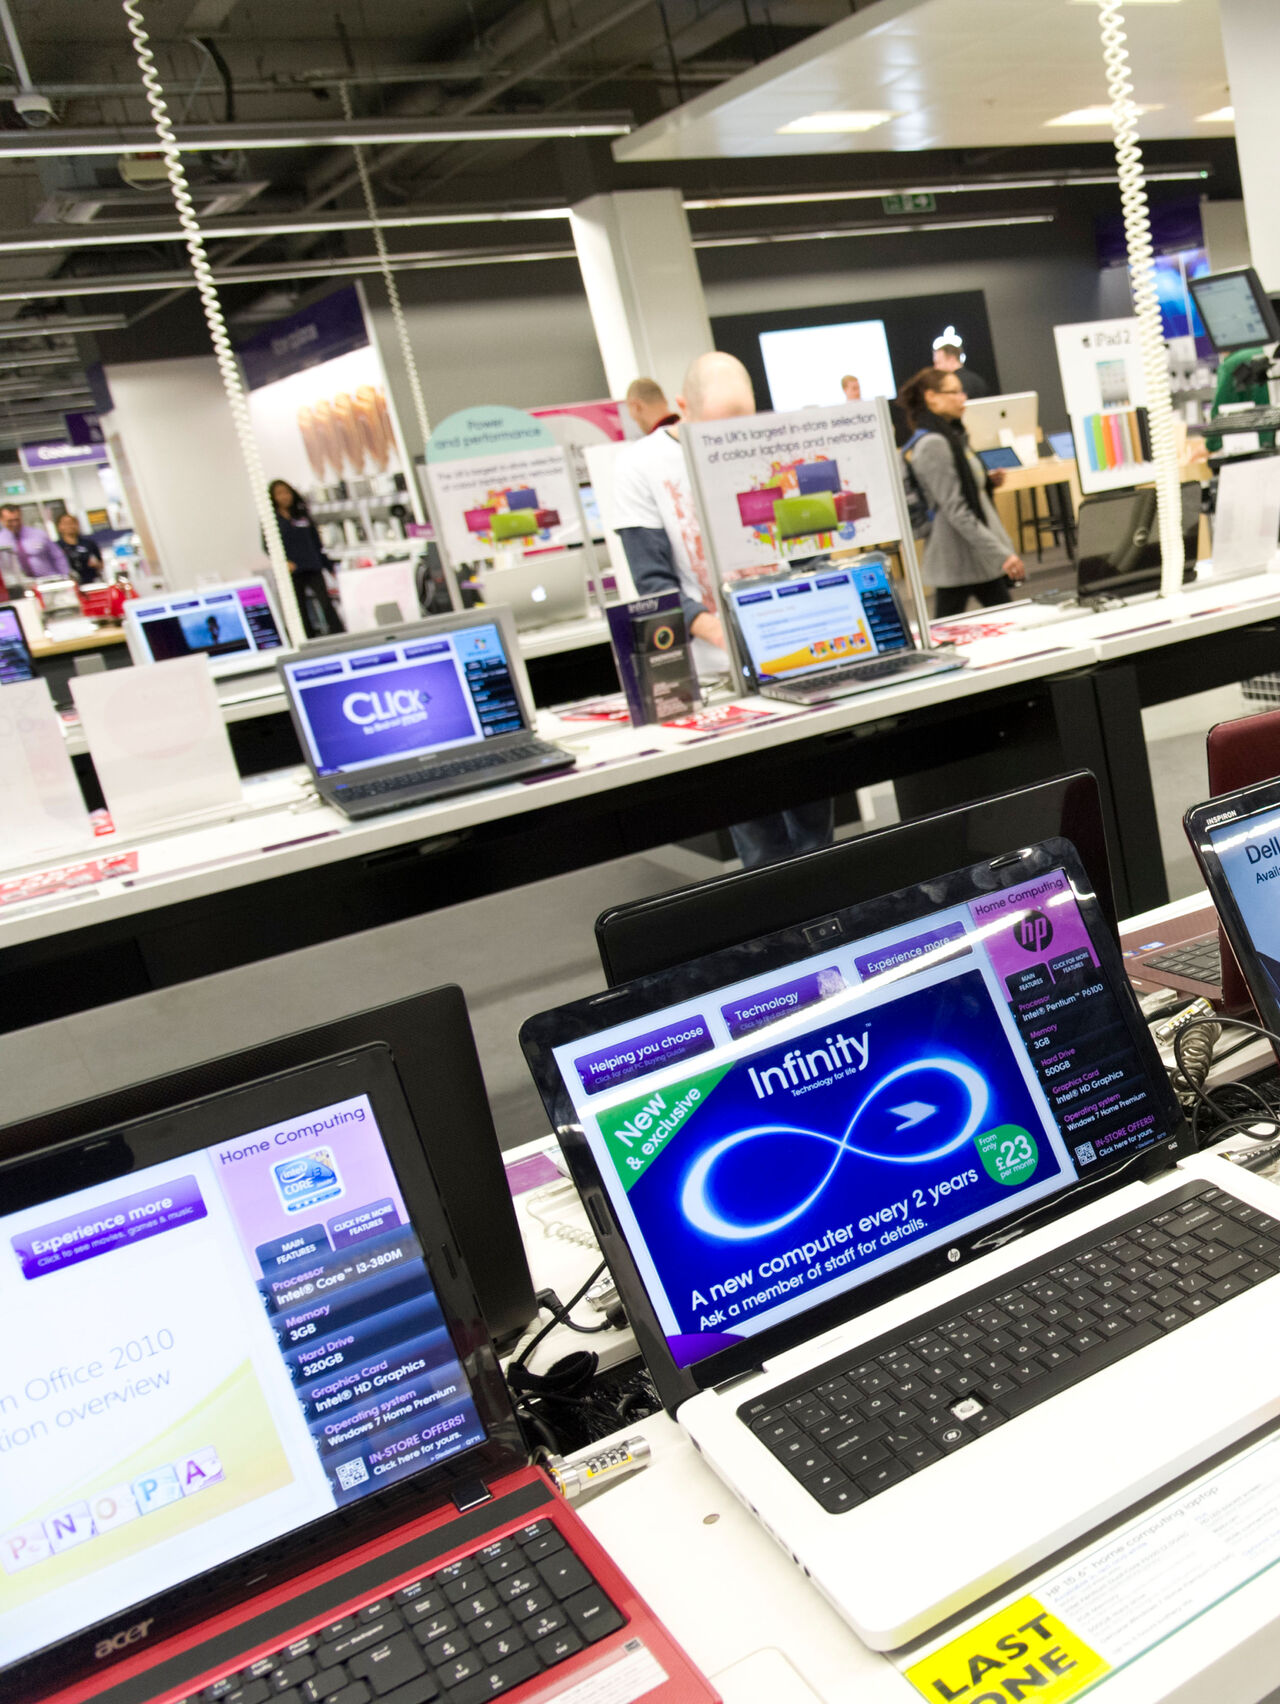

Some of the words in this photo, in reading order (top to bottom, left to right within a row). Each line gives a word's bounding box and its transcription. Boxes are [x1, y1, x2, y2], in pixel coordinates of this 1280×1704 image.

[701, 434, 722, 447] The
[724, 431, 747, 445] UK's
[750, 425, 788, 442] largest
[790, 419, 828, 434] in-store
[831, 412, 876, 428] selection
[708, 451, 720, 464] of
[722, 447, 756, 461] colour
[760, 440, 800, 457] laptops
[802, 436, 824, 449] and
[342, 689, 425, 725] CLICK
[1206, 809, 1238, 826] INSPIRON
[975, 898, 1006, 916] Home
[1007, 878, 1064, 904] Computing
[1021, 917, 1047, 951] hp
[867, 944, 922, 974] Experience
[1063, 962, 1084, 974] FEATURES
[1019, 978, 1044, 991] FEATURES
[1021, 972, 1036, 982] MAIN
[1082, 984, 1103, 998] P6100
[735, 991, 799, 1021] Technology
[1018, 996, 1050, 1011] Processor
[1030, 1024, 1057, 1039] Memory
[1034, 1037, 1050, 1049] 3GB
[589, 1051, 636, 1075] Helping
[637, 1043, 659, 1061] you
[661, 1026, 704, 1048] choose
[1041, 1055, 1058, 1066] Hard
[1058, 1048, 1076, 1060] Drive
[791, 1076, 834, 1098] Technology
[846, 1066, 857, 1078] life
[1045, 1061, 1071, 1077] 500GB
[1079, 1084, 1091, 1094] HD
[1091, 1070, 1123, 1089] Graphics
[1052, 1078, 1083, 1094] Graphics
[614, 1092, 668, 1149] New
[1063, 1103, 1097, 1123] Operating
[1098, 1093, 1120, 1108] system
[1067, 1113, 1095, 1132] Windows
[1100, 1101, 1118, 1117] Home
[1119, 1091, 1146, 1109] Premium
[219, 1140, 271, 1165] Home
[274, 1108, 366, 1145] Computing
[625, 1153, 645, 1173] &
[641, 1086, 701, 1158] exclusive
[978, 1133, 998, 1147] From
[1095, 1128, 1127, 1148] IN-STORE
[1128, 1116, 1155, 1133] OFFERS!
[995, 1135, 1033, 1172] £23
[1014, 1157, 1036, 1175] month
[1099, 1146, 1114, 1157] Click
[284, 1179, 315, 1195] CORE
[30, 1213, 126, 1256] Experience
[128, 1197, 173, 1221] more
[370, 1204, 393, 1219] MORE
[349, 1218, 384, 1236] FEATURES
[689, 1290, 709, 1312] A
[710, 1267, 754, 1303] new
[758, 1222, 855, 1279] computer
[858, 1198, 909, 1234] every
[911, 1189, 927, 1209] 2
[928, 1166, 979, 1208] years
[276, 1244, 317, 1265] FEATURES
[281, 1238, 304, 1252] MAIN
[272, 1266, 324, 1292] Processor
[699, 1308, 727, 1332] Ask
[728, 1302, 741, 1318] a
[742, 1274, 804, 1311] member
[807, 1264, 823, 1281] of
[824, 1246, 856, 1277] staff
[857, 1238, 878, 1258] for
[879, 1217, 929, 1252] details.
[285, 1304, 330, 1328] Memory
[290, 1323, 317, 1341] 3GB
[298, 1346, 325, 1364] Hard
[327, 1334, 355, 1352] Drive
[303, 1352, 344, 1376] 320GB
[24, 1360, 104, 1402] Office
[110, 1328, 175, 1370] 2010
[311, 1372, 361, 1400] Graphics
[361, 1360, 388, 1378] Card
[353, 1381, 372, 1396] HD
[374, 1358, 426, 1387] Graphics
[55, 1370, 171, 1428] overview
[324, 1404, 379, 1436] Operating
[380, 1389, 417, 1412] system
[328, 1422, 373, 1447] Windows
[383, 1404, 413, 1424] Home
[414, 1384, 456, 1409] Premium
[369, 1435, 420, 1464] IN-STORE
[421, 1413, 466, 1440] OFFERS!
[373, 1460, 396, 1476] Click
[397, 1449, 420, 1465] here
[434, 1430, 462, 1450] yours.
[1046, 1584, 1061, 1597] HP
[1092, 1545, 1125, 1568] home
[1126, 1508, 1185, 1547] computing
[1185, 1486, 1219, 1510] laptop
[95, 1618, 154, 1659] acer
[931, 1612, 1054, 1703] LAST
